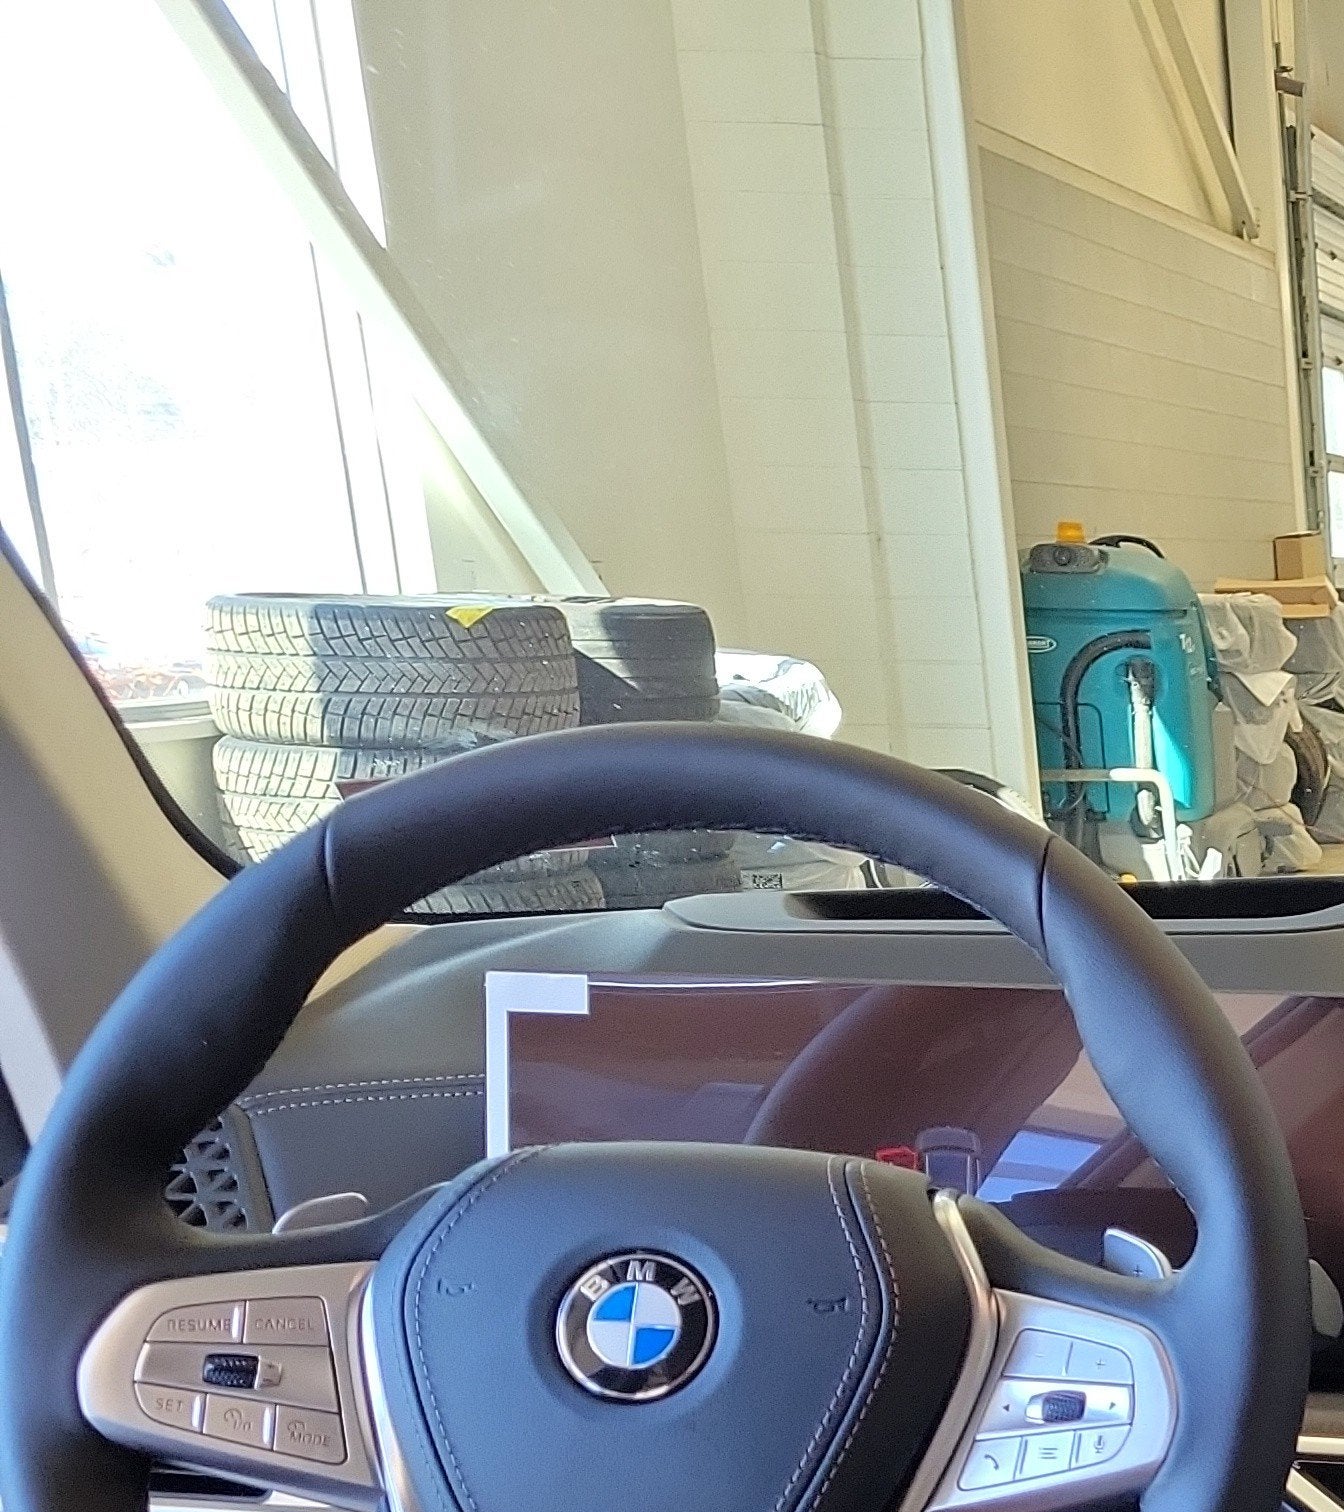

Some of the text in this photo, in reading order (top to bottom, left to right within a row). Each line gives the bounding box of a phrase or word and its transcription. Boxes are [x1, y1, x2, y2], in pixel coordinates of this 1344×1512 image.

[580, 1260, 701, 1306] BMW
[166, 1318, 231, 1332] RESUME
[255, 1317, 312, 1331] CANCEL
[156, 1399, 184, 1413] SET
